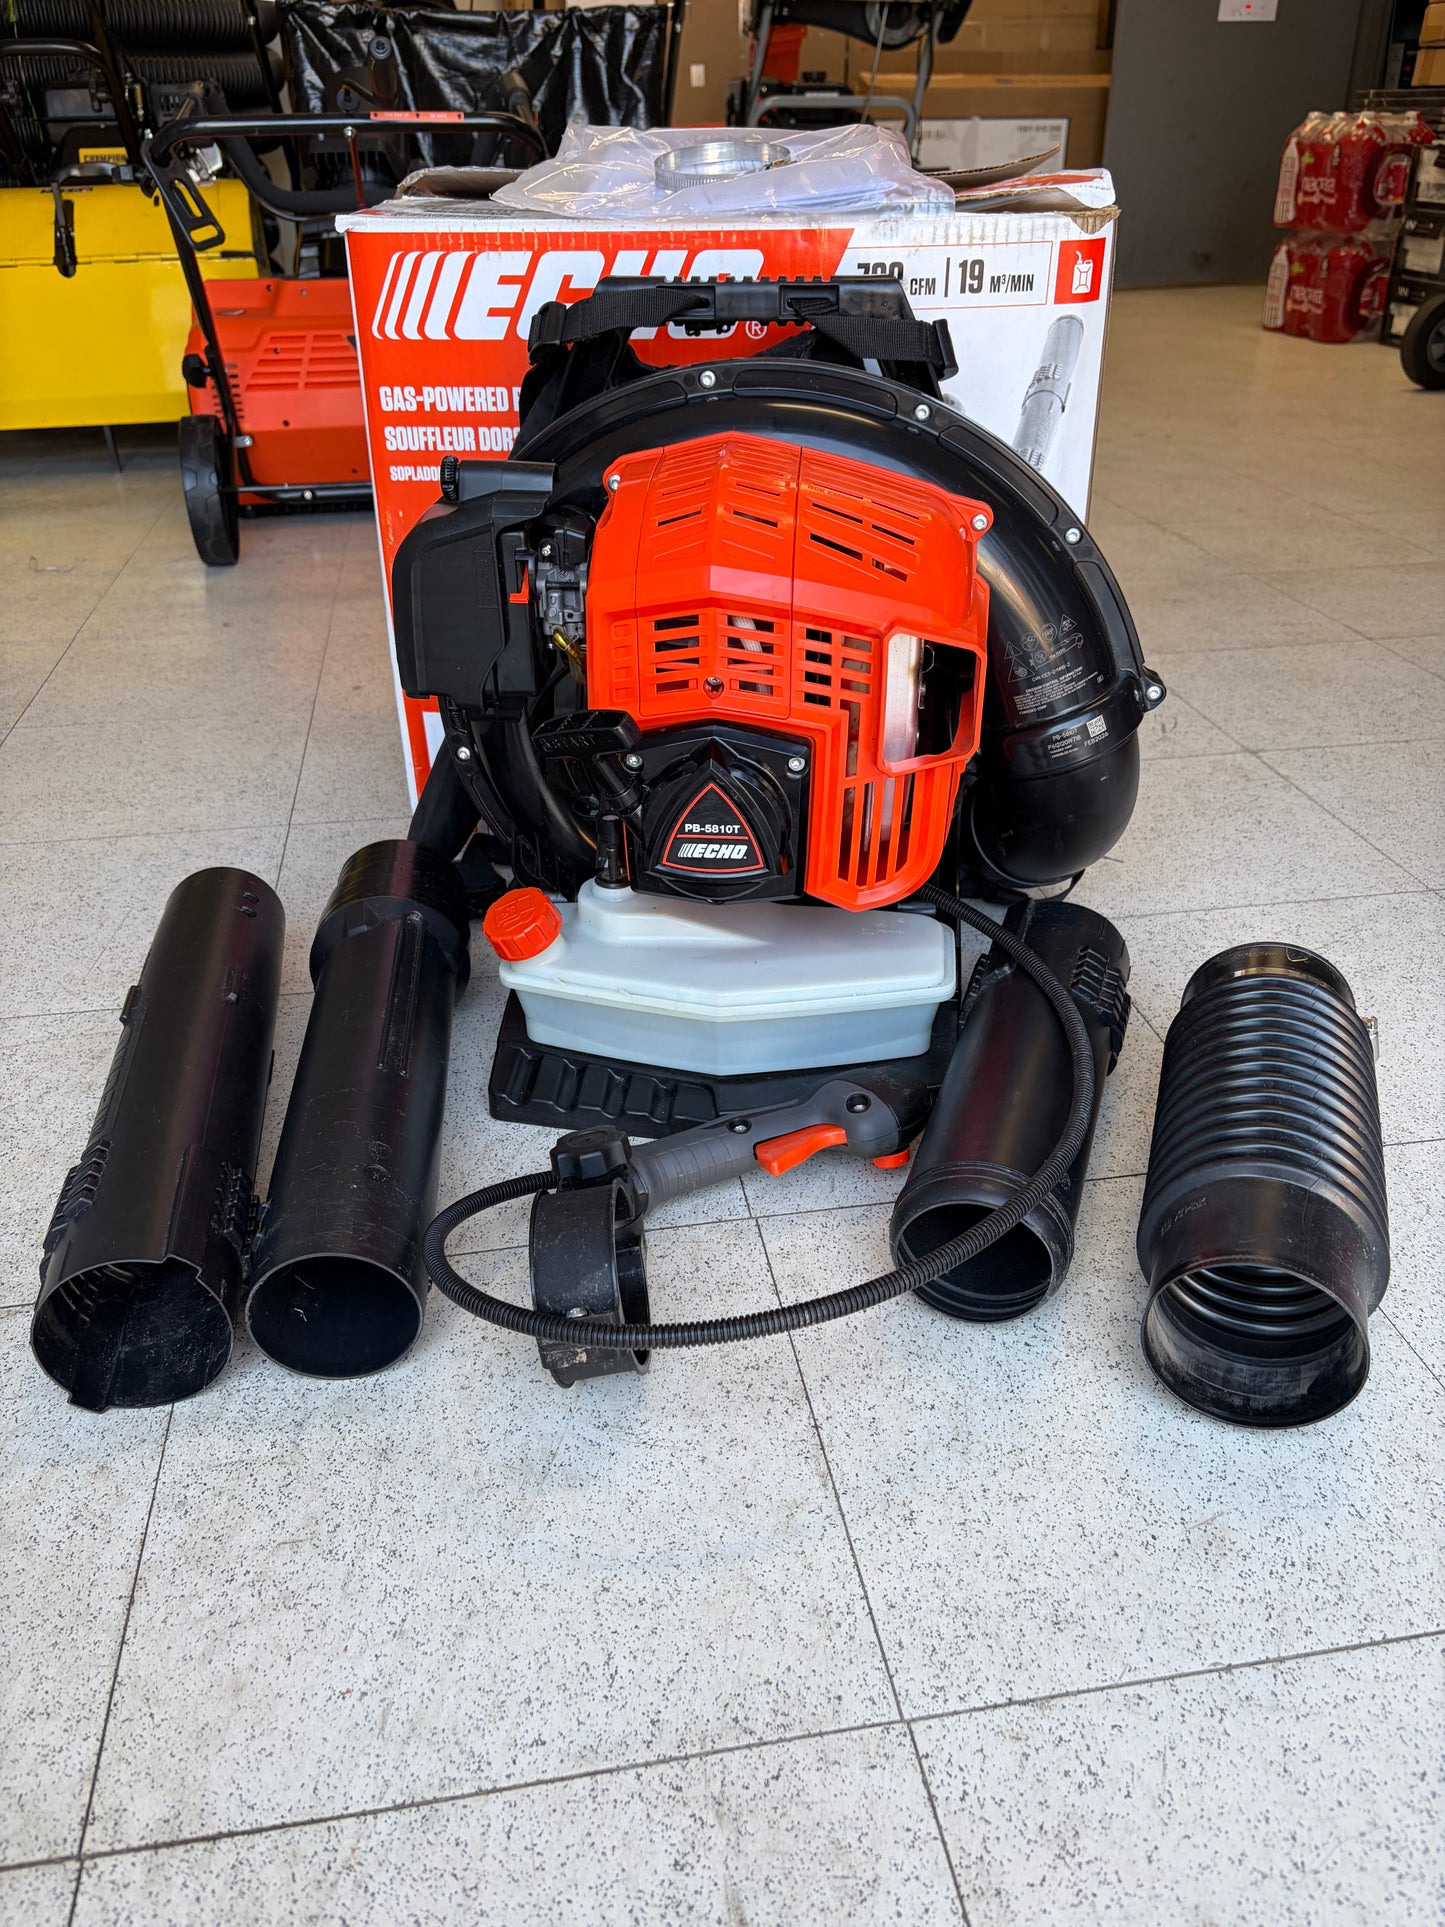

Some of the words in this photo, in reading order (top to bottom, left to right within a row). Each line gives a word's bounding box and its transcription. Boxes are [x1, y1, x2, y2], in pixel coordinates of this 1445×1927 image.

[909, 277, 936, 296] CFM
[959, 259, 985, 294] 19
[379, 386, 509, 412] GAS-POWERED
[384, 426, 475, 451] SOUFFLEUR
[389, 466, 441, 481] SOPLADO
[685, 823, 740, 834] PB-5810T
